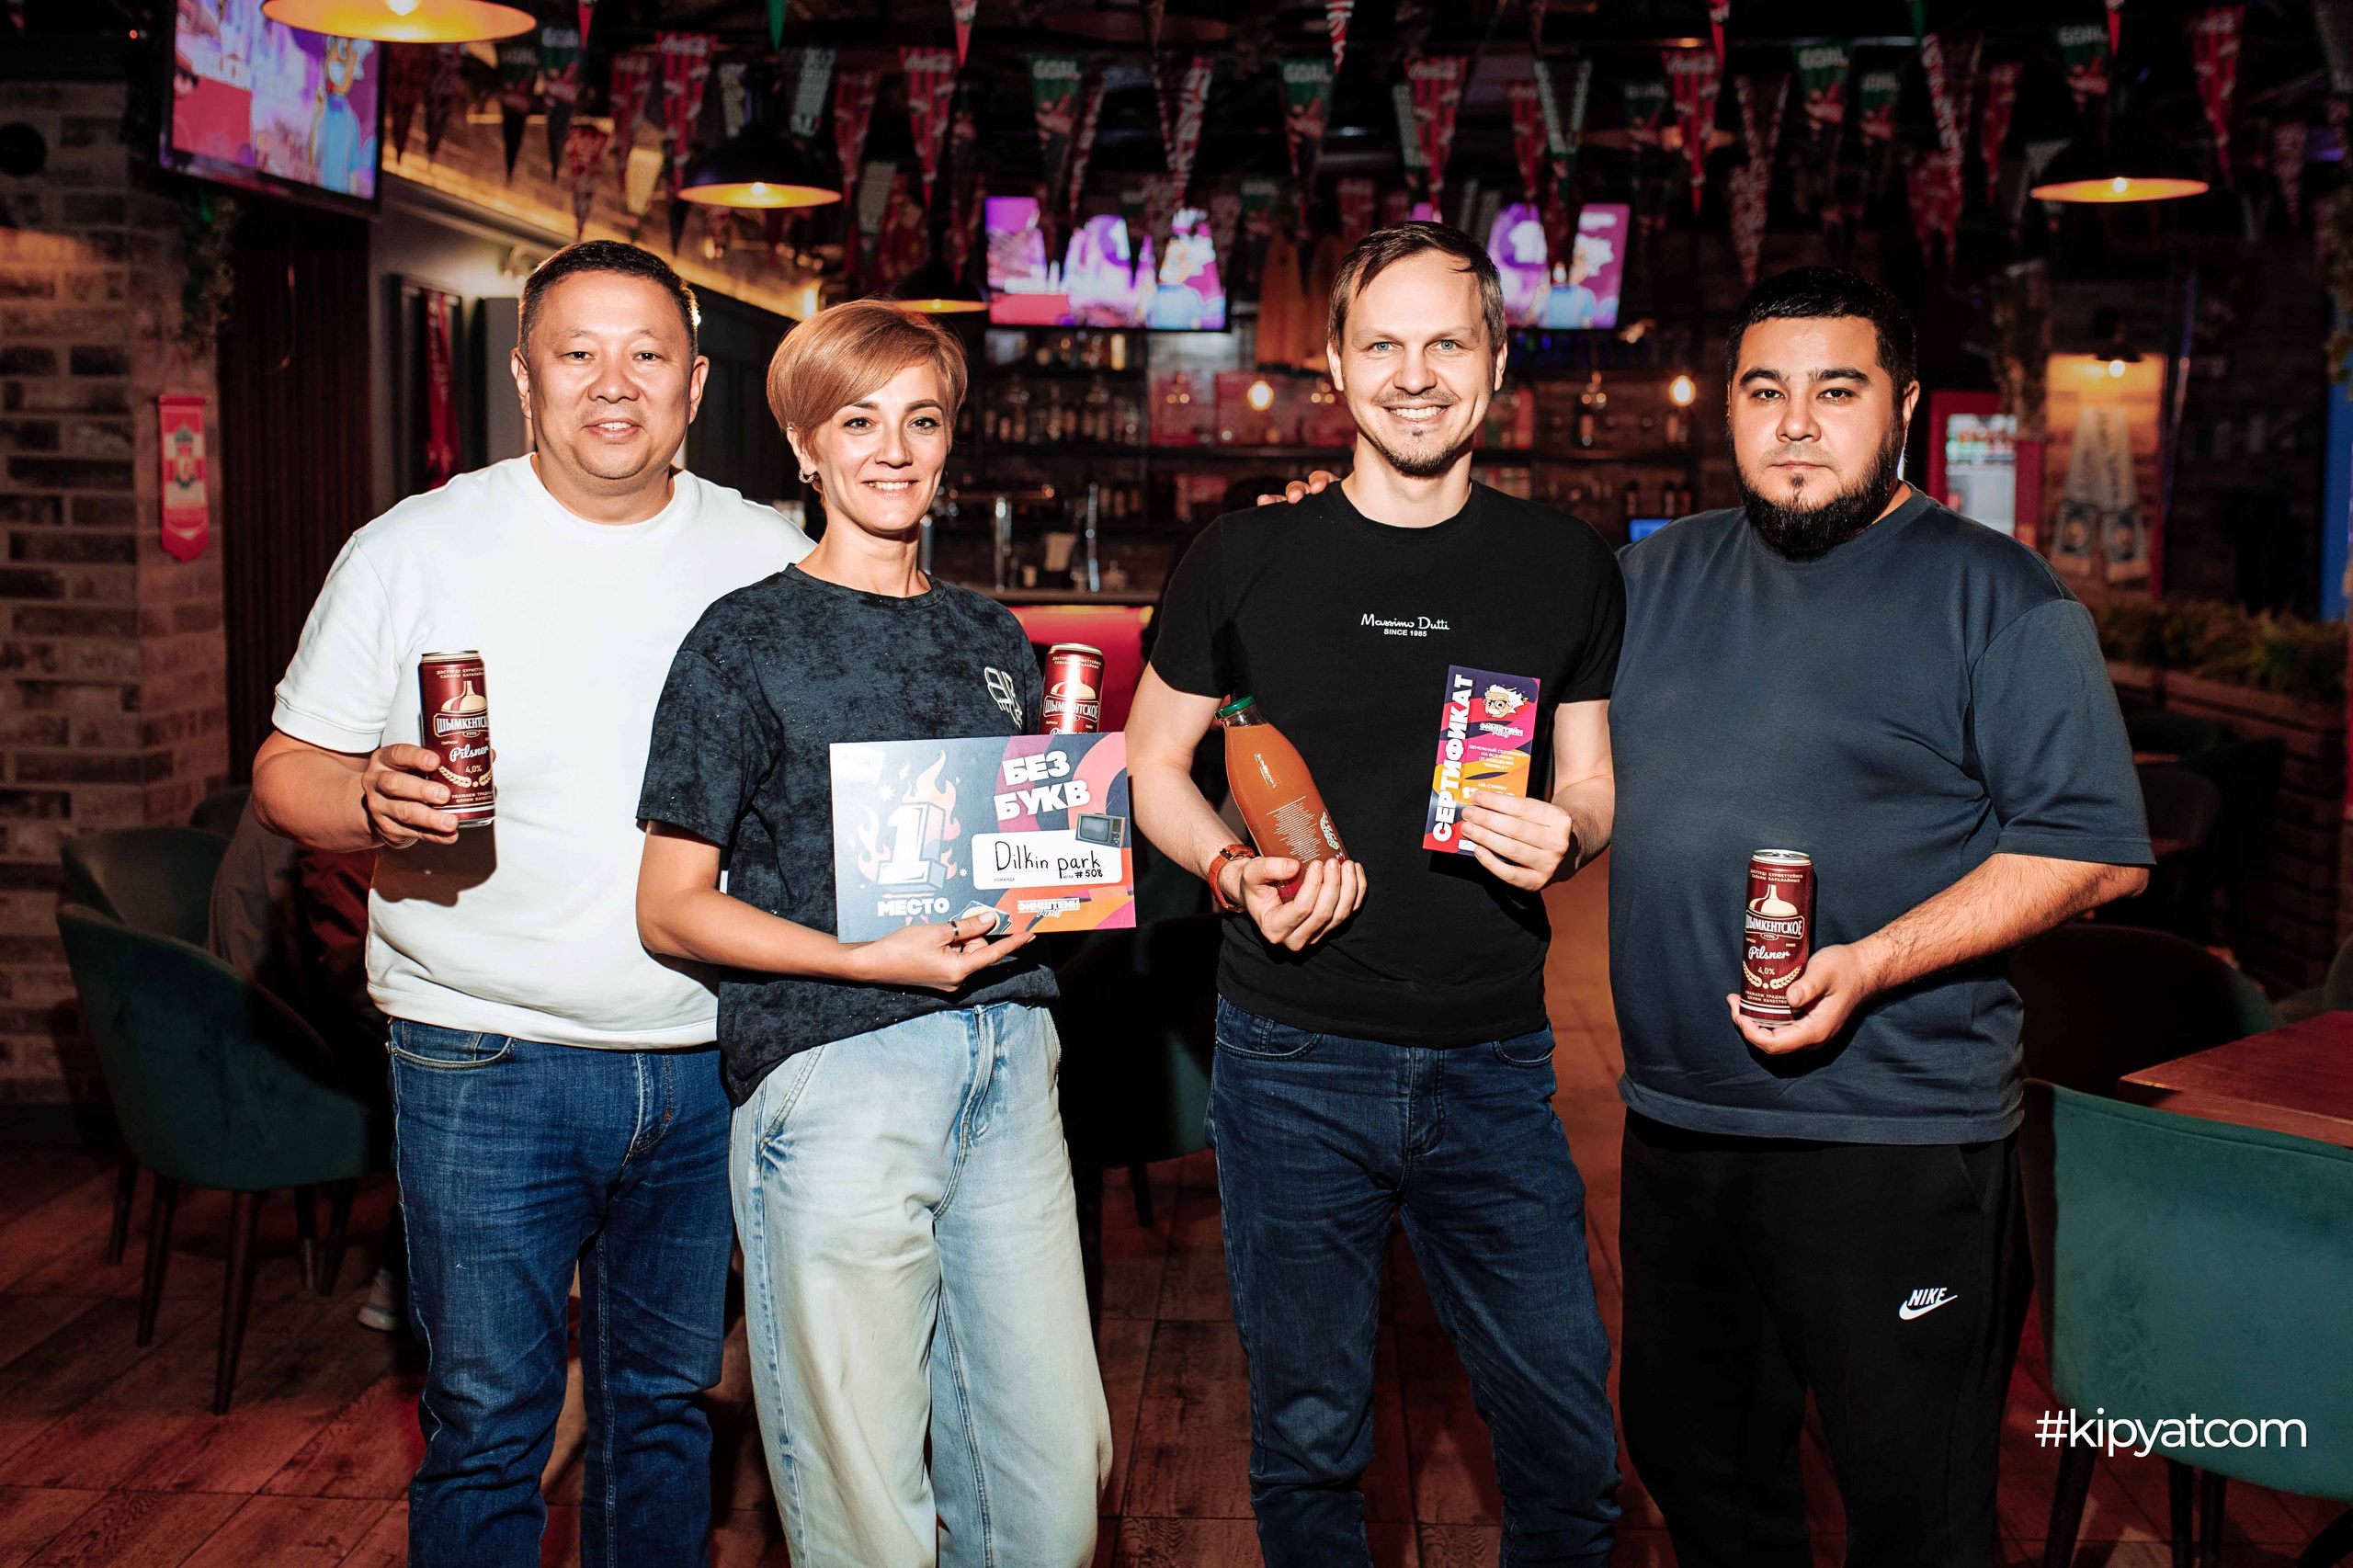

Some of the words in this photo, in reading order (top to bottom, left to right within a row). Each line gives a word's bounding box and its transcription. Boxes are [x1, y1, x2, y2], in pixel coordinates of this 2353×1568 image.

[1360, 613, 1415, 628] Massimo
[1417, 616, 1450, 631] Dutti
[1383, 628, 1408, 636] SINCE
[449, 744, 489, 763] Pilsner
[1433, 674, 1473, 842] СЕРТИФИКАТ
[1002, 750, 1071, 787] БЕЗ
[994, 779, 1091, 822] БУКВ
[995, 840, 1049, 871] Dilkin
[1057, 850, 1101, 880] park
[877, 897, 950, 917] МЕСТО
[1748, 945, 1790, 960] Pilsner
[1757, 967, 1775, 975] 4,0%
[1907, 1287, 1948, 1306] NIKE
